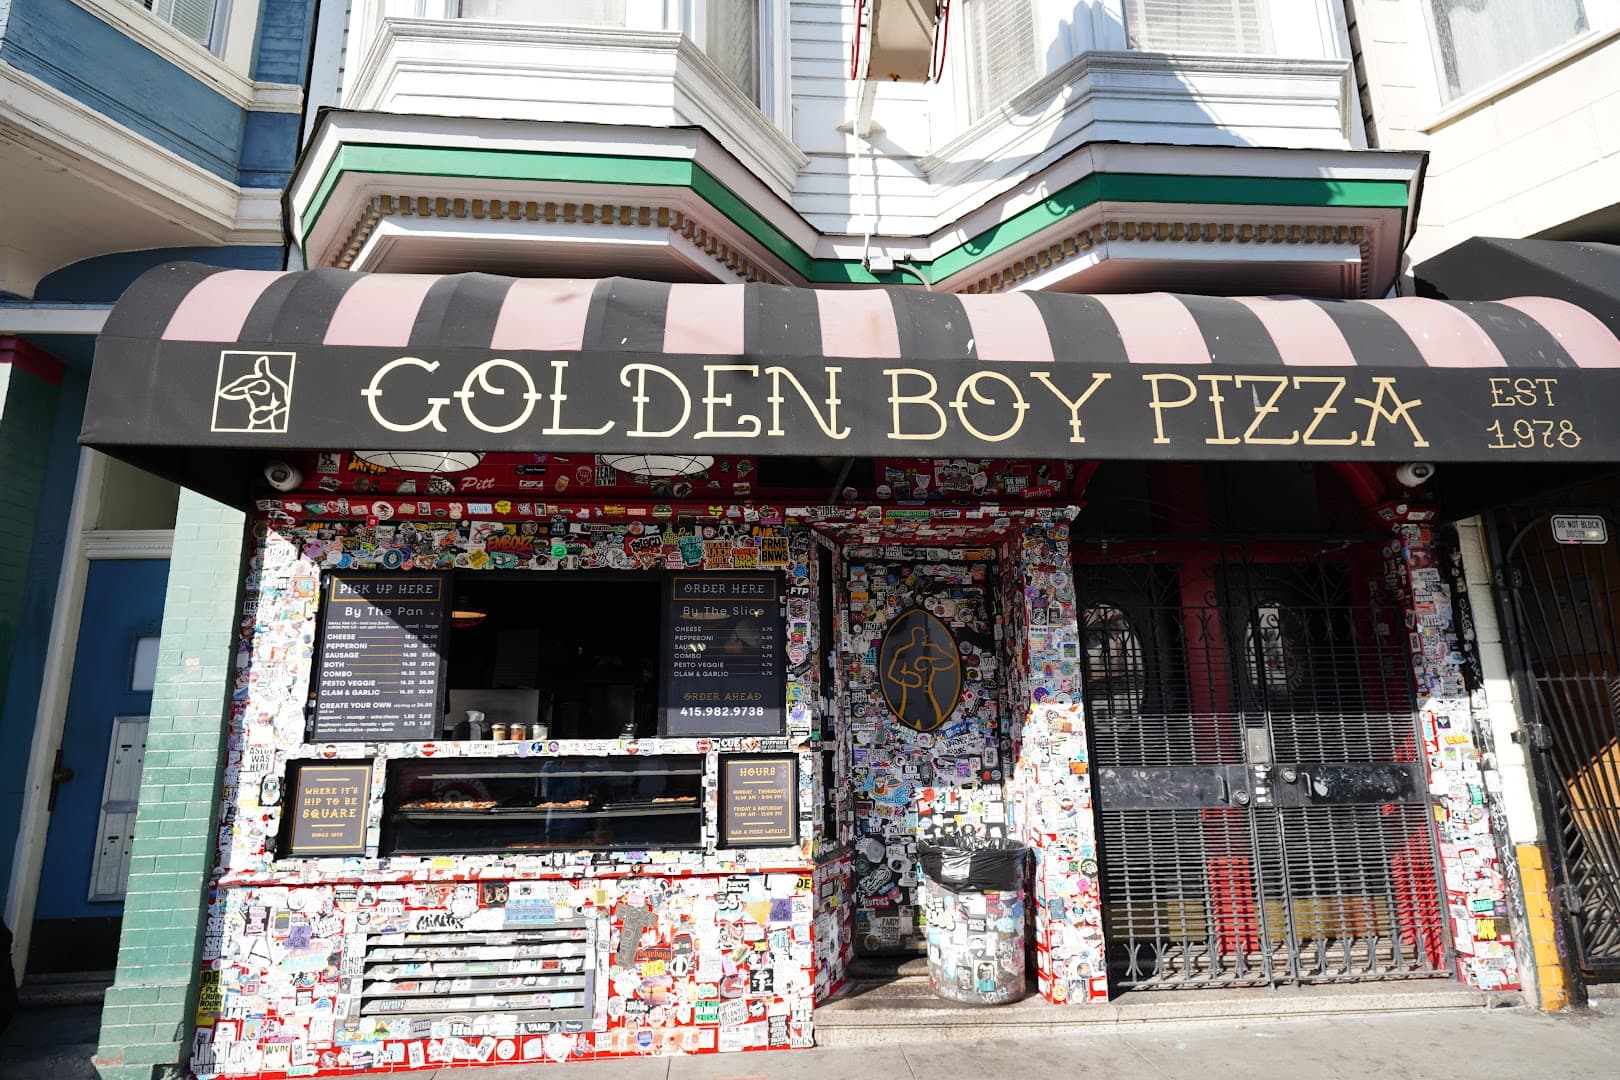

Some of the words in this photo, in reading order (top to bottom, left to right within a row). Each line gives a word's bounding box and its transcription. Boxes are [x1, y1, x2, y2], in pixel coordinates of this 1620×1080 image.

[1489, 378, 1557, 407] EST
[361, 356, 852, 440] GOLDEN
[882, 368, 1112, 444] BOY
[1142, 373, 1430, 447] PIZZA
[1487, 419, 1582, 450] 1978
[461, 477, 495, 491] Pitt
[1557, 520, 1566, 528] DO
[1567, 520, 1579, 528] NOT
[1581, 520, 1600, 528] BLOCK
[339, 584, 370, 594] PICK
[376, 584, 393, 594] UP
[399, 584, 434, 594] HERE
[684, 584, 726, 593] ORDER
[732, 584, 765, 593] HERE
[790, 587, 809, 595] FTP
[345, 607, 361, 618] By
[368, 607, 392, 616] The
[399, 607, 424, 616] Pan
[683, 607, 698, 618] By
[704, 607, 727, 616] The
[733, 607, 765, 616] Slice
[680, 707, 764, 717] 415.982.9738
[252, 755, 270, 763] WAS
[740, 767, 776, 777] HOURS
[305, 787, 337, 795] WHERE
[304, 798, 322, 806] HIP
[345, 797, 358, 805] BE
[302, 809, 357, 819] SQUARE
